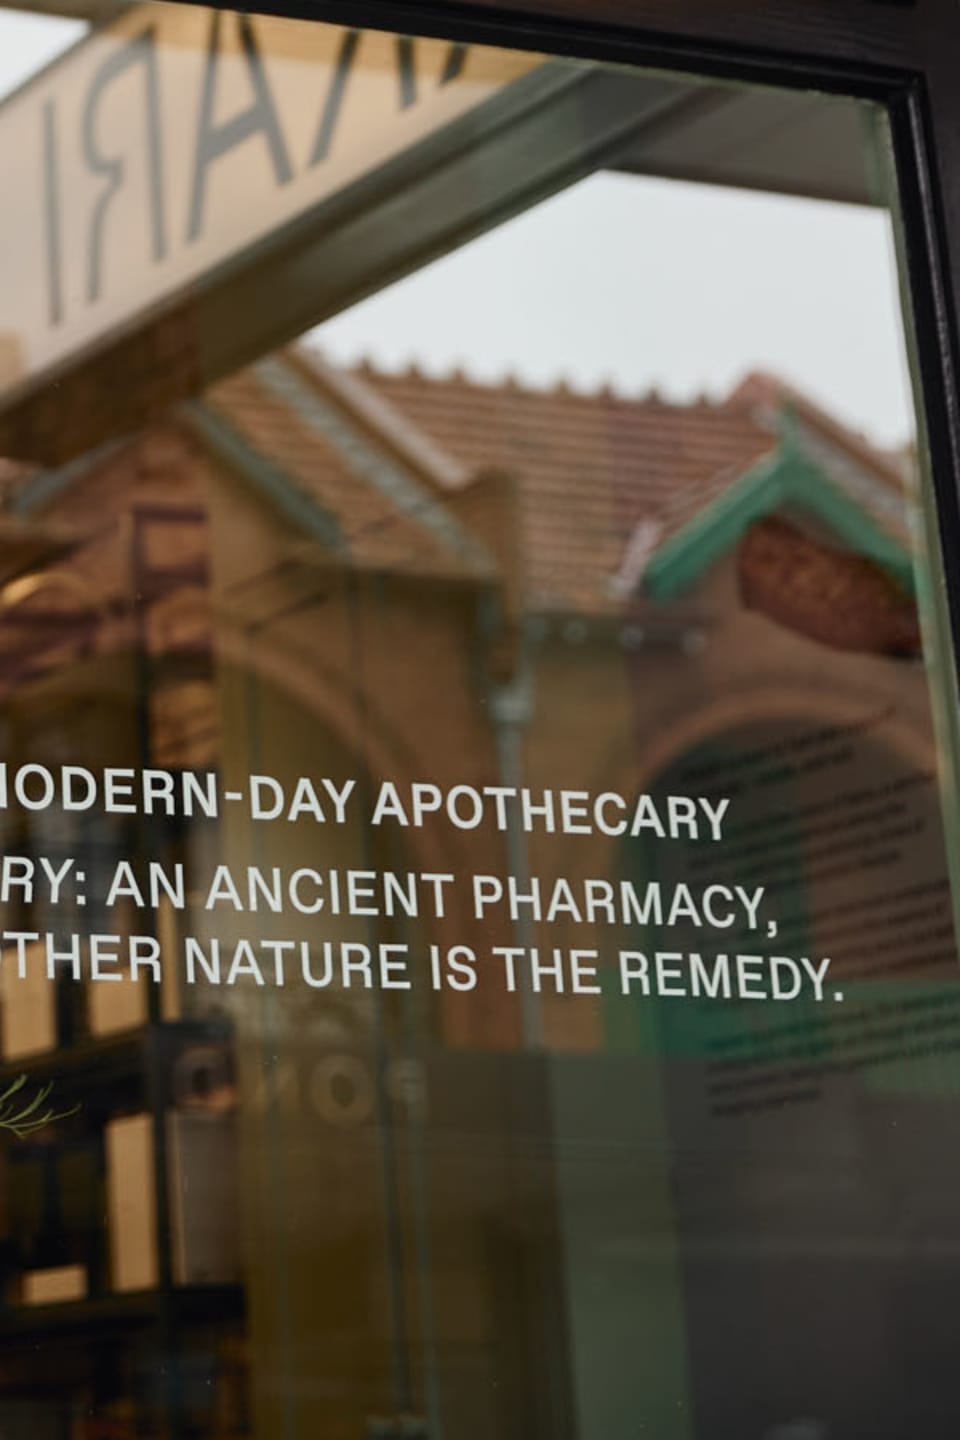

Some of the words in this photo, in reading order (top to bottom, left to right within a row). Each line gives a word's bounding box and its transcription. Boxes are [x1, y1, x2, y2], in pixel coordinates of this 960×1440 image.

[371, 781, 730, 841] APOTHECARY
[105, 860, 186, 909] AN
[204, 864, 455, 918] ANCIENT
[472, 874, 779, 939] PHARMACY,
[184, 937, 412, 990] NATURE
[430, 944, 478, 992] IS
[491, 946, 602, 995] THE
[618, 950, 845, 1002] REMEDY.
